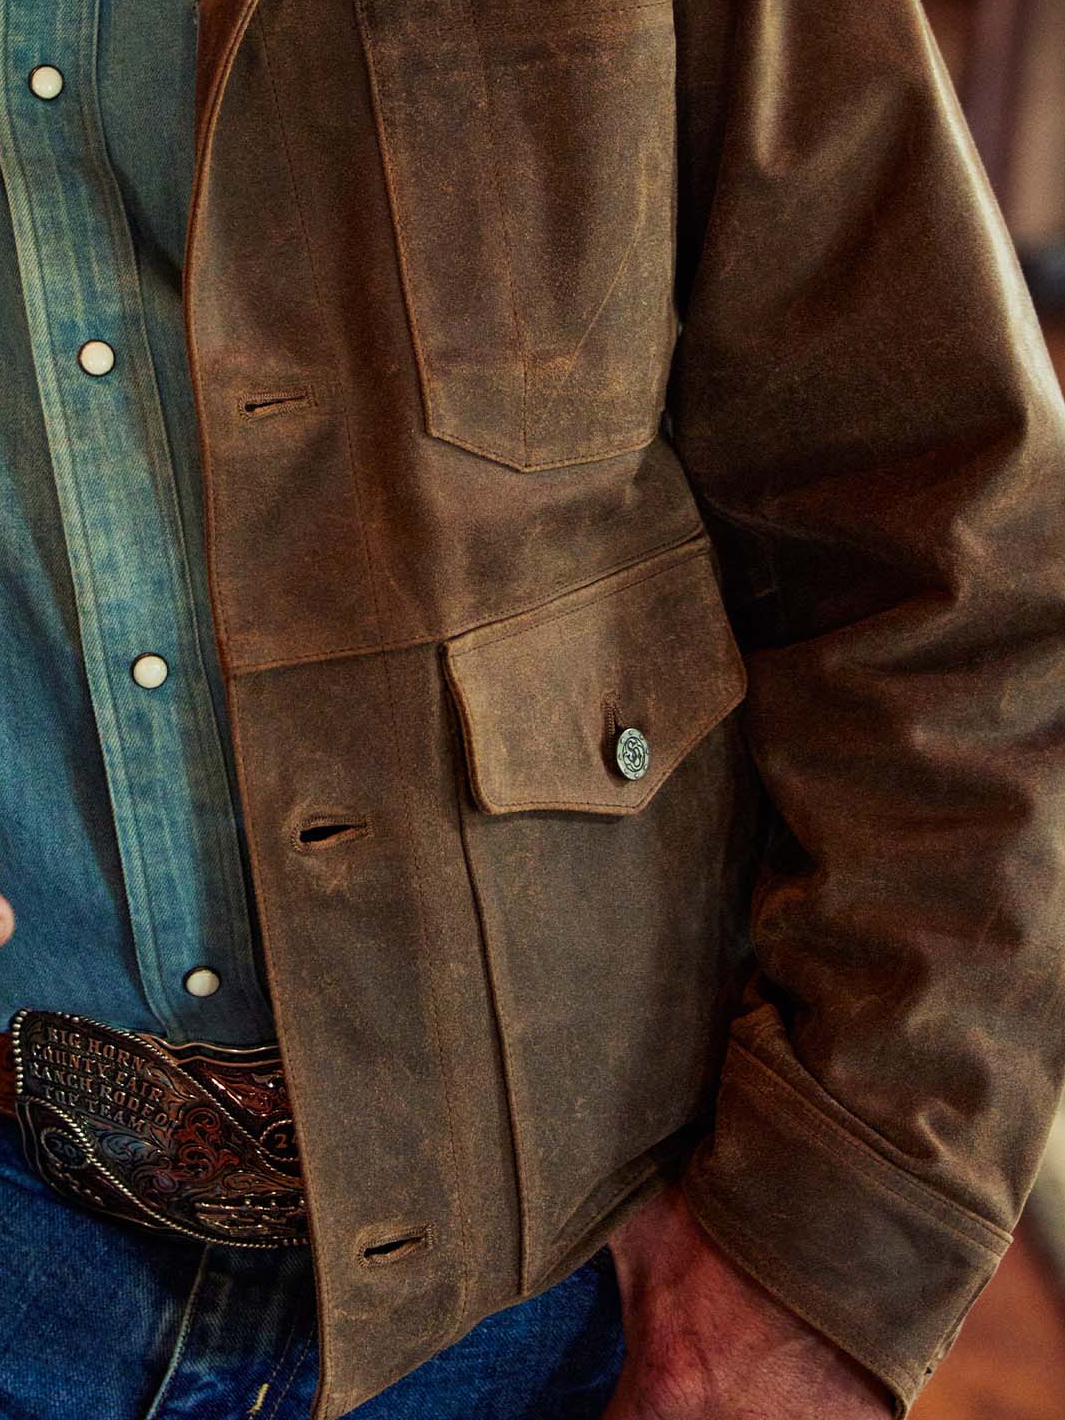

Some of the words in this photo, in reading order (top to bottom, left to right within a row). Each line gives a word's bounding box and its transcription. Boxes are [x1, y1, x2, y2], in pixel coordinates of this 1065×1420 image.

[31, 1044, 112, 1080] COUNTY
[116, 1070, 164, 1104] FAIR
[47, 1027, 80, 1049] BIG
[88, 1039, 151, 1076] HORN
[31, 1062, 93, 1093] RANCH
[99, 1084, 168, 1126] RODEO
[42, 1083, 79, 1107] TOP
[85, 1099, 147, 1133] TEAM
